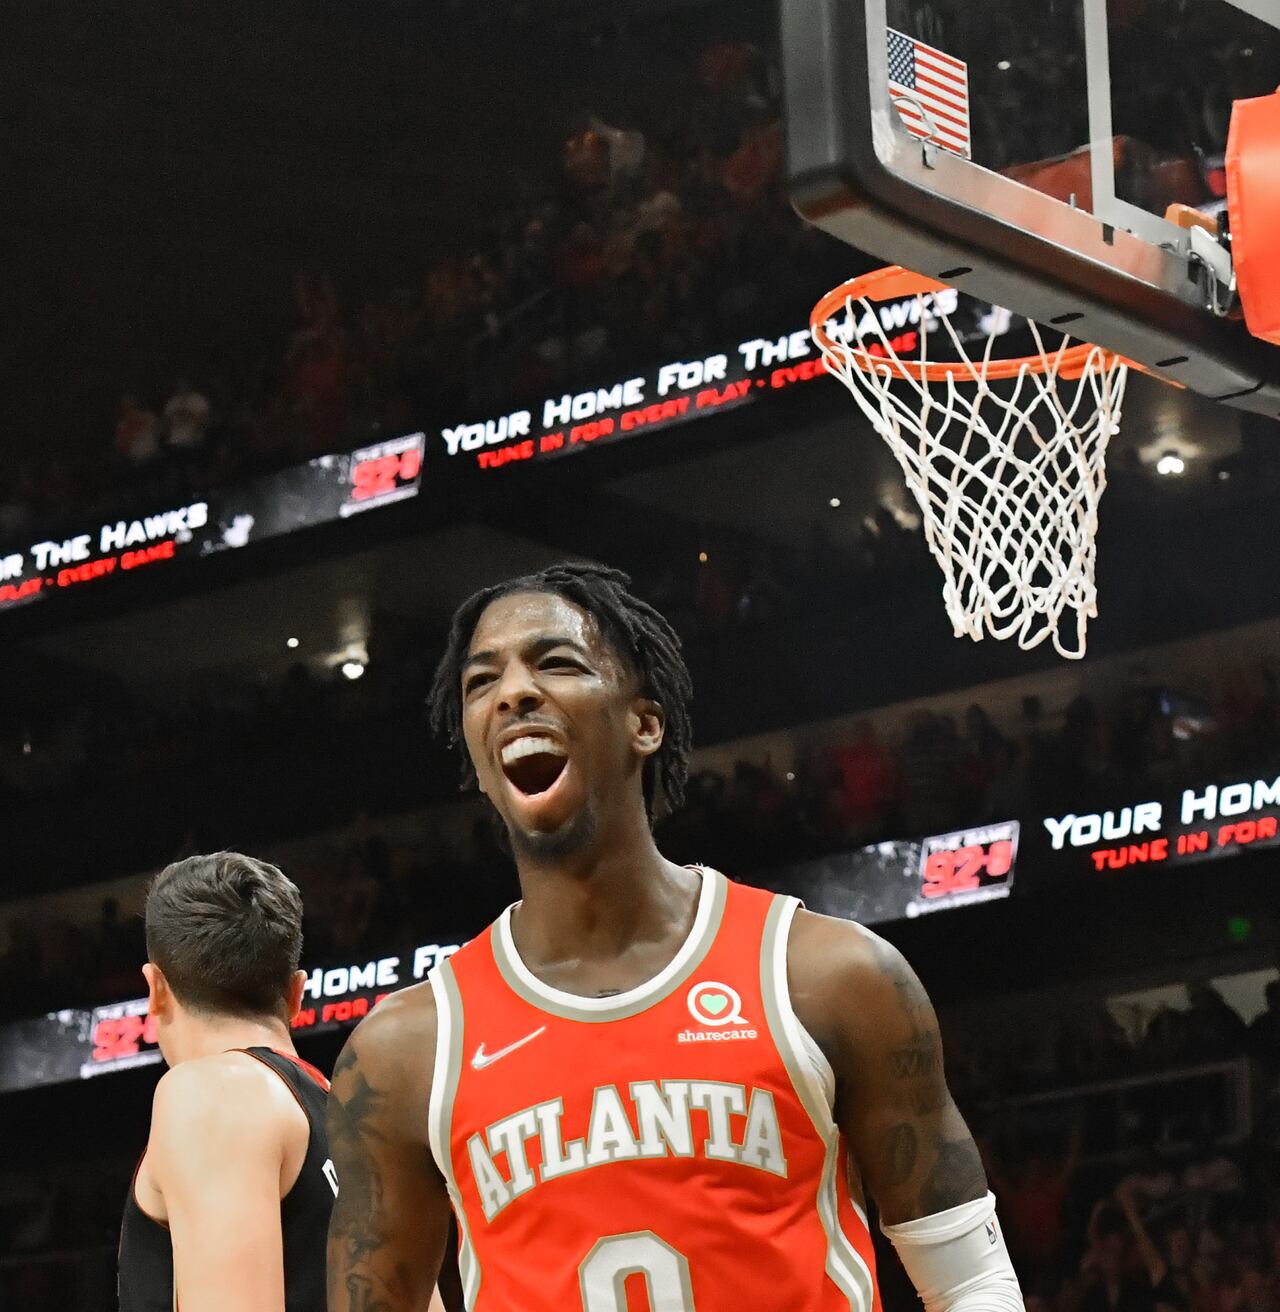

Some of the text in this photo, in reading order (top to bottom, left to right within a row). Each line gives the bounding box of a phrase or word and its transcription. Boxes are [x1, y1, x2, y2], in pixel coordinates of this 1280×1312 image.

[441, 410, 531, 456] YOUR
[542, 377, 646, 429] HOME
[657, 354, 728, 397] FOR
[738, 322, 815, 371] THE
[30, 534, 91, 571] THE
[100, 502, 208, 552] HAWKS
[1043, 801, 1163, 850] YOUR
[1091, 838, 1169, 871] TUNE
[1176, 831, 1210, 854] IN
[1217, 816, 1278, 846] FOR
[322, 998, 368, 1022] FOR
[677, 1026, 758, 1045] sharecare
[467, 1080, 788, 1224] ATLANTA
